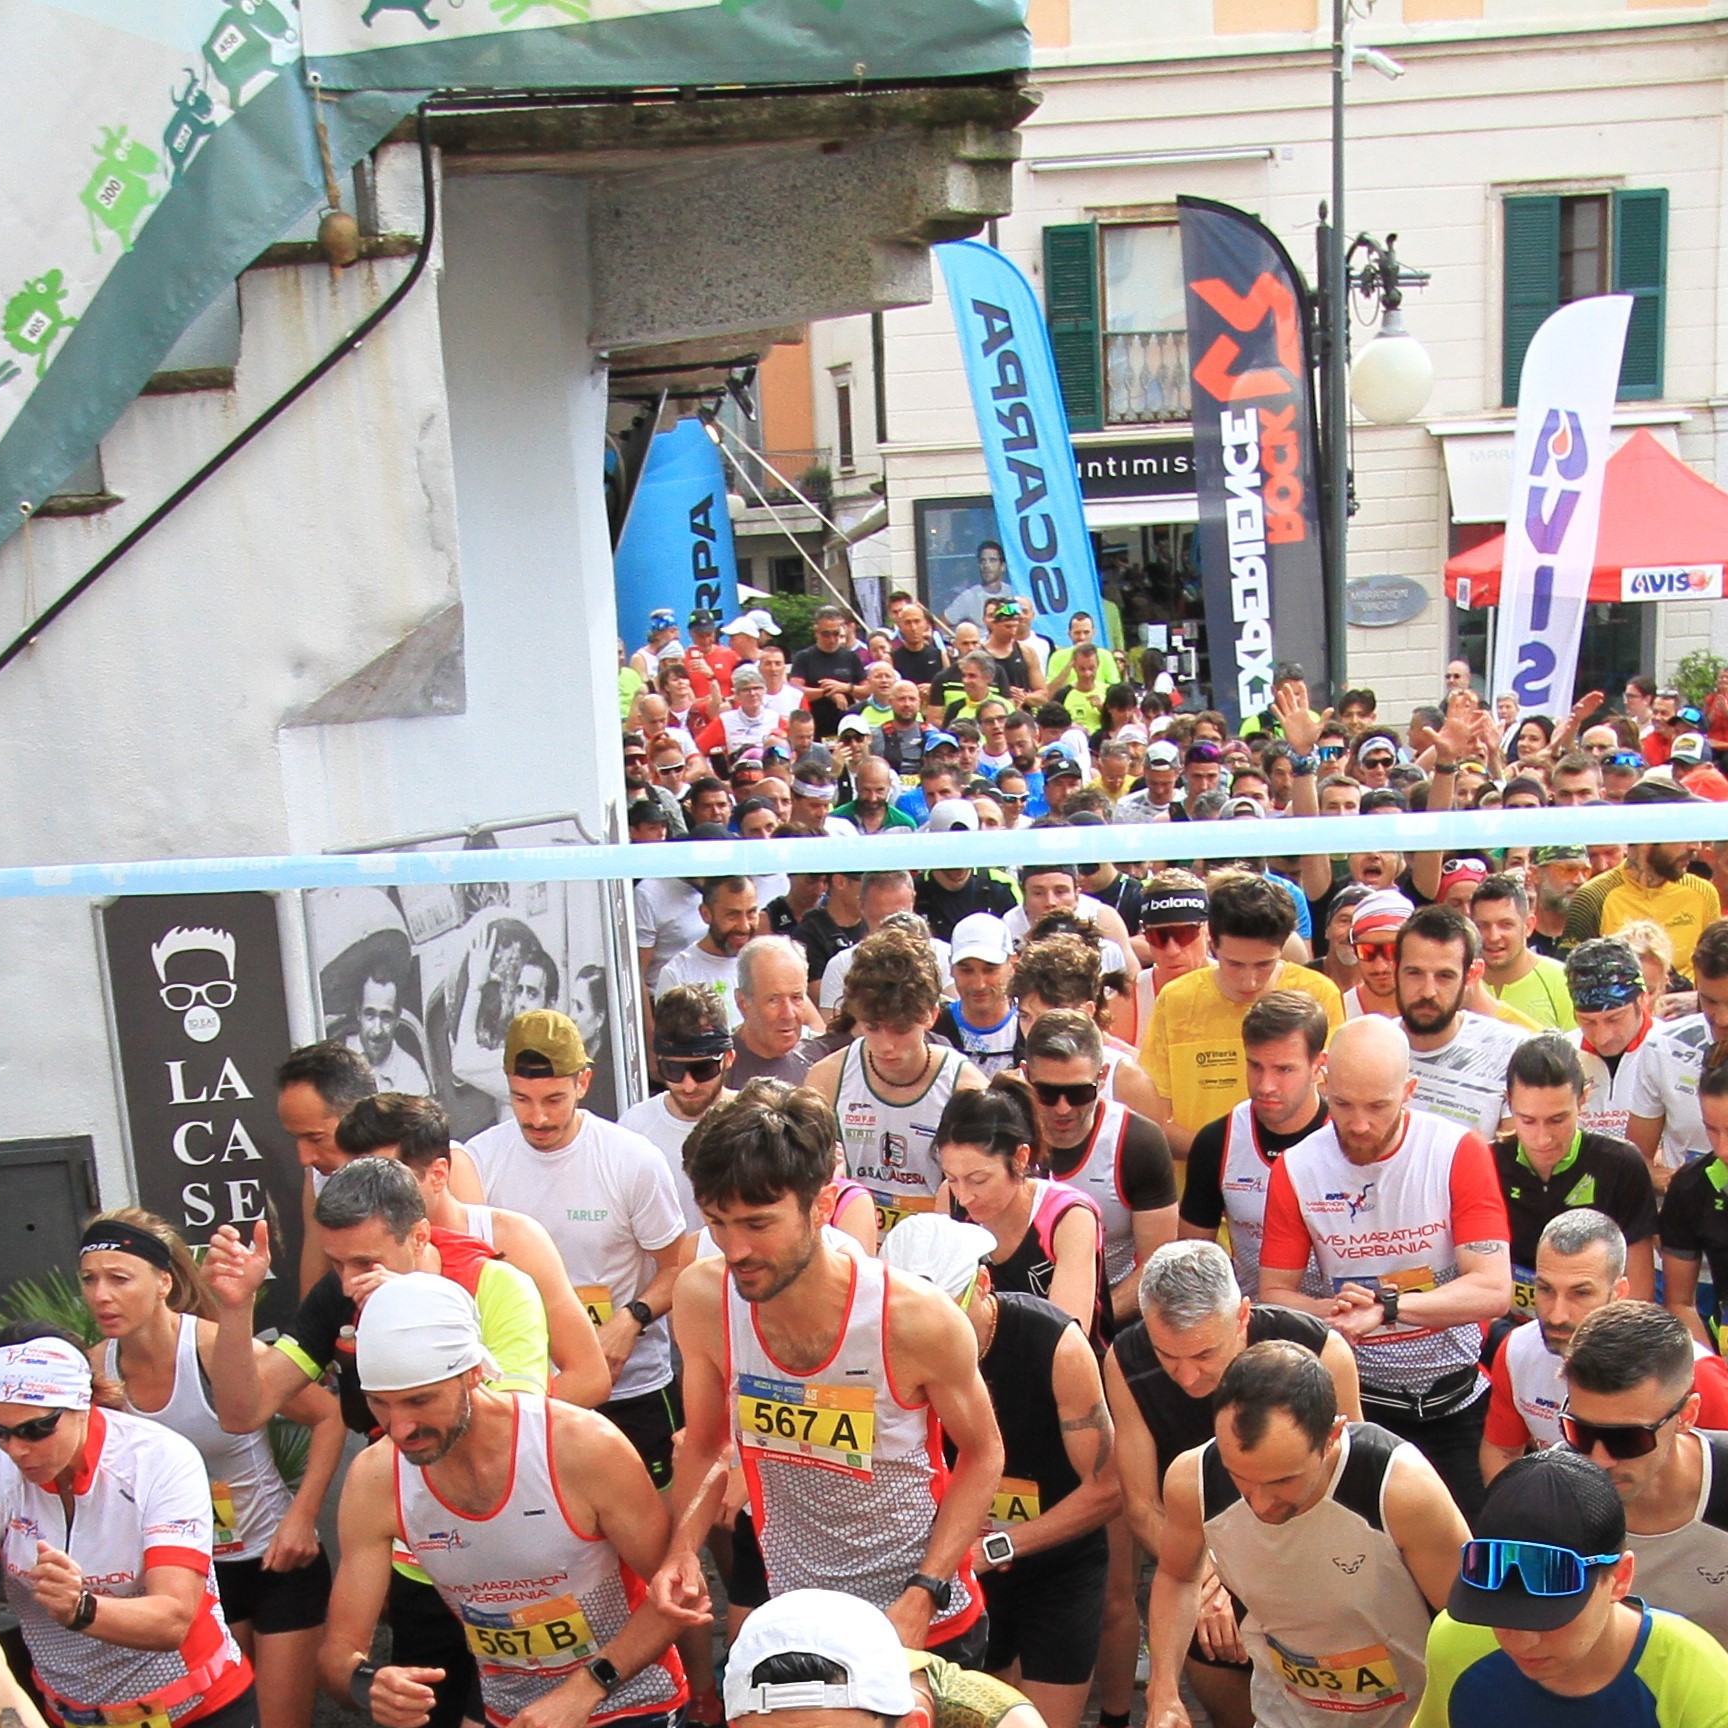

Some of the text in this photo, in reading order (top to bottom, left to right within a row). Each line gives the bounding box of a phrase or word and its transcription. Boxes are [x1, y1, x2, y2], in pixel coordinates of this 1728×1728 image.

[100, 180, 121, 206] 300
[1076, 453, 1198, 481] intimiss
[688, 493, 724, 628] RPA
[1630, 574, 1690, 594] AVIS
[165, 1057, 254, 1105] LA
[172, 1118, 263, 1166] CA
[183, 1179, 266, 1227] SE
[566, 1208, 609, 1221] TARLEP
[1349, 1219, 1448, 1245] MARATHON
[1332, 1240, 1433, 1260] VERBANIA
[754, 1402, 859, 1450] 567 A
[1007, 1496, 1031, 1522] A
[473, 1571, 569, 1593] MARATHON
[475, 1619, 578, 1657] 567 B
[1282, 1662, 1386, 1692] 503 A
